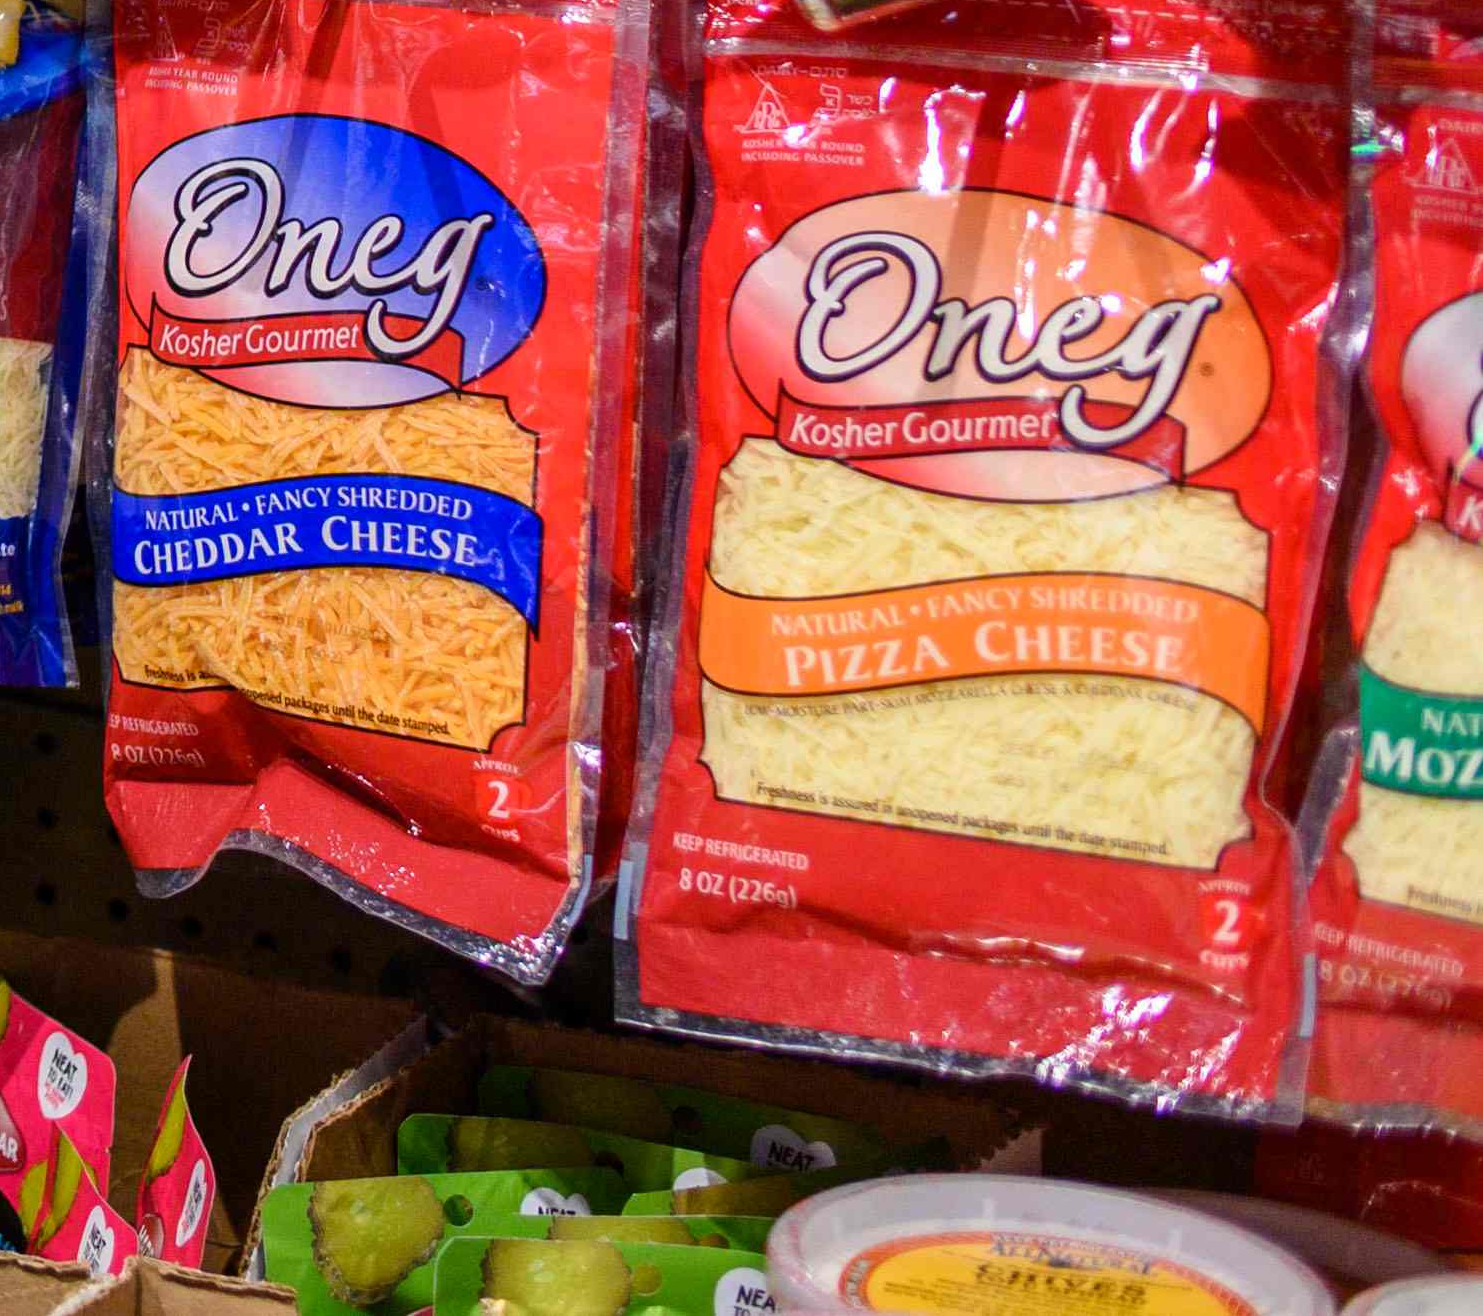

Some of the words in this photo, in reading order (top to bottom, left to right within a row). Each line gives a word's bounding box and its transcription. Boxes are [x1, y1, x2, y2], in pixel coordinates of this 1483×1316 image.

[162, 156, 495, 364] Oneg
[159, 325, 244, 357] Kosher
[245, 322, 359, 354] Gourmet
[796, 230, 1224, 452] Oneg
[790, 411, 898, 450] Kosher
[902, 408, 1056, 448] Gourmet
[145, 503, 239, 532] NATURAL
[255, 487, 331, 516] FANCY
[336, 485, 473, 522] SHREDDED
[133, 518, 303, 576] CHEDDAR
[321, 513, 480, 568] CHEESE
[770, 604, 907, 638] NATURAL
[927, 584, 1020, 618] FANCY
[1029, 584, 1202, 624] SHREDDED
[784, 634, 949, 688] PIZZA
[975, 620, 1186, 675] CHEESE
[672, 830, 704, 851] KEEP
[704, 834, 810, 872] REFRIGERATED
[678, 867, 692, 891] 8
[696, 870, 725, 899] OZ
[728, 874, 799, 910] (226g)
[1214, 900, 1240, 943] 2
[52, 1047, 79, 1079] NEAT
[767, 1141, 816, 1170] NEAT
